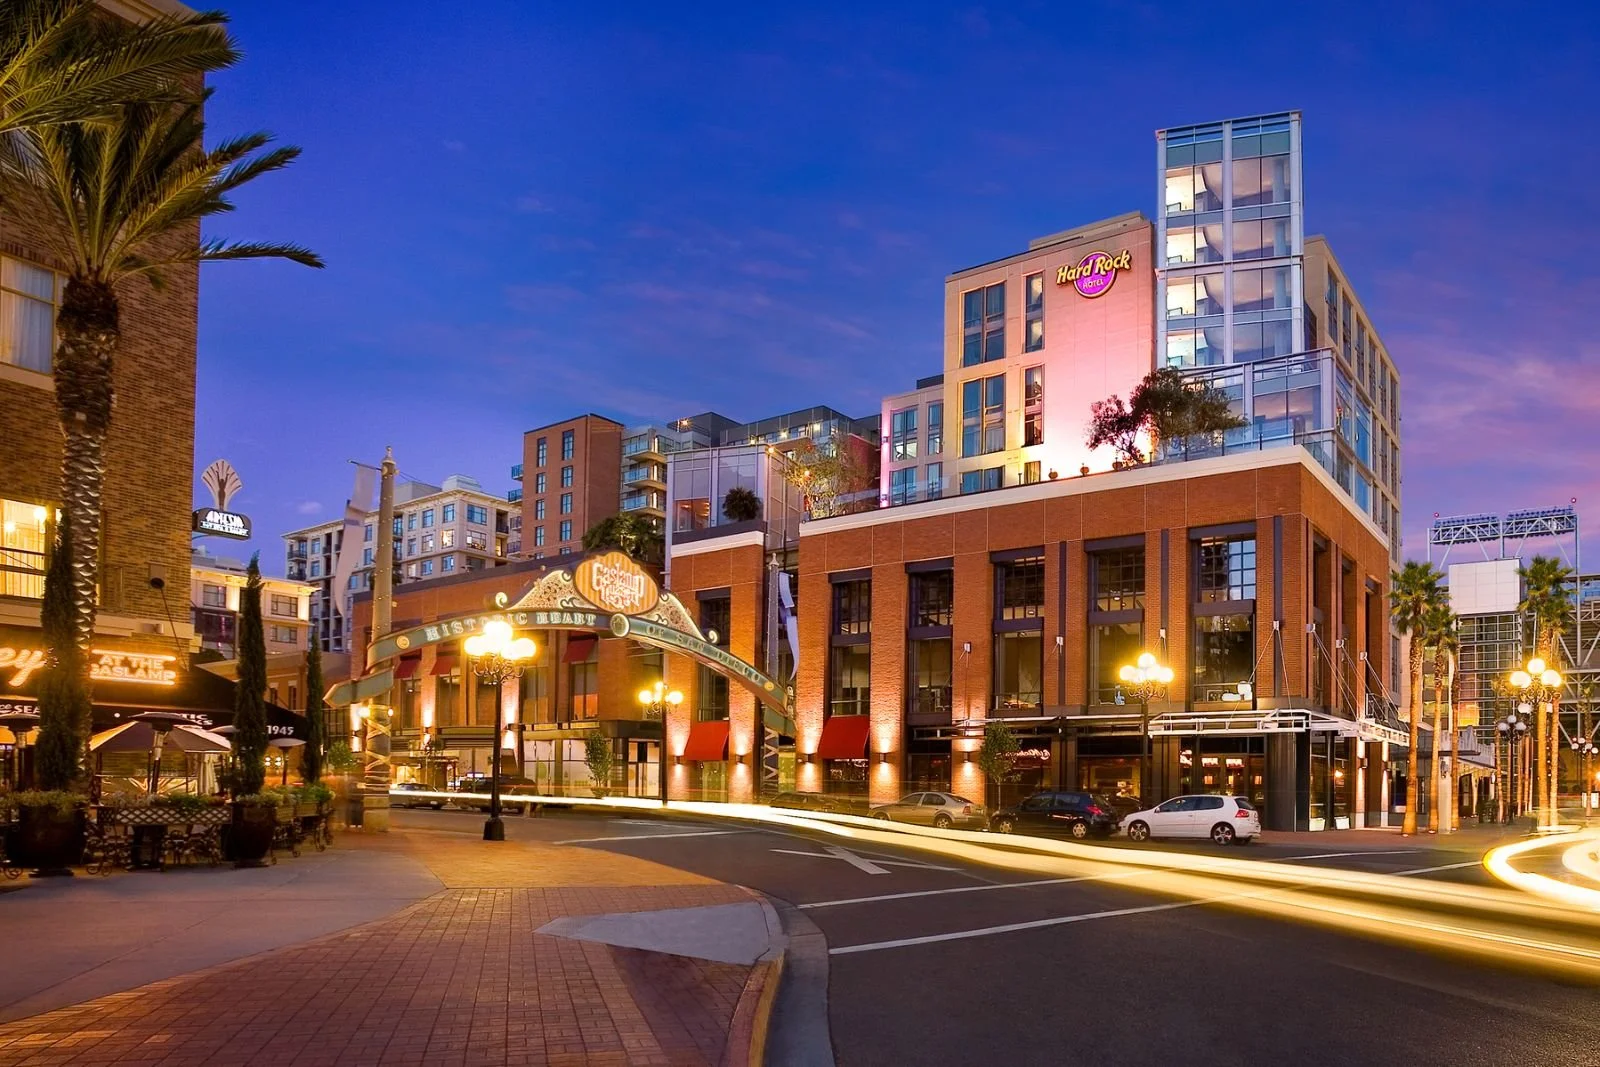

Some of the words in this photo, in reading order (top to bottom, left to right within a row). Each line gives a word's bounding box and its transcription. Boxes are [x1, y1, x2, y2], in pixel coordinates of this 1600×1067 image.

[1056, 259, 1093, 284] Hard
[1095, 250, 1131, 275] Rock
[1083, 279, 1104, 289] HOTEL
[536, 611, 596, 626] HEART
[646, 625, 665, 636] OF
[676, 634, 705, 652] SAN
[716, 651, 761, 682] DIEGO
[98, 654, 125, 667] AT
[127, 656, 165, 670] THE
[266, 725, 294, 735] 1945
